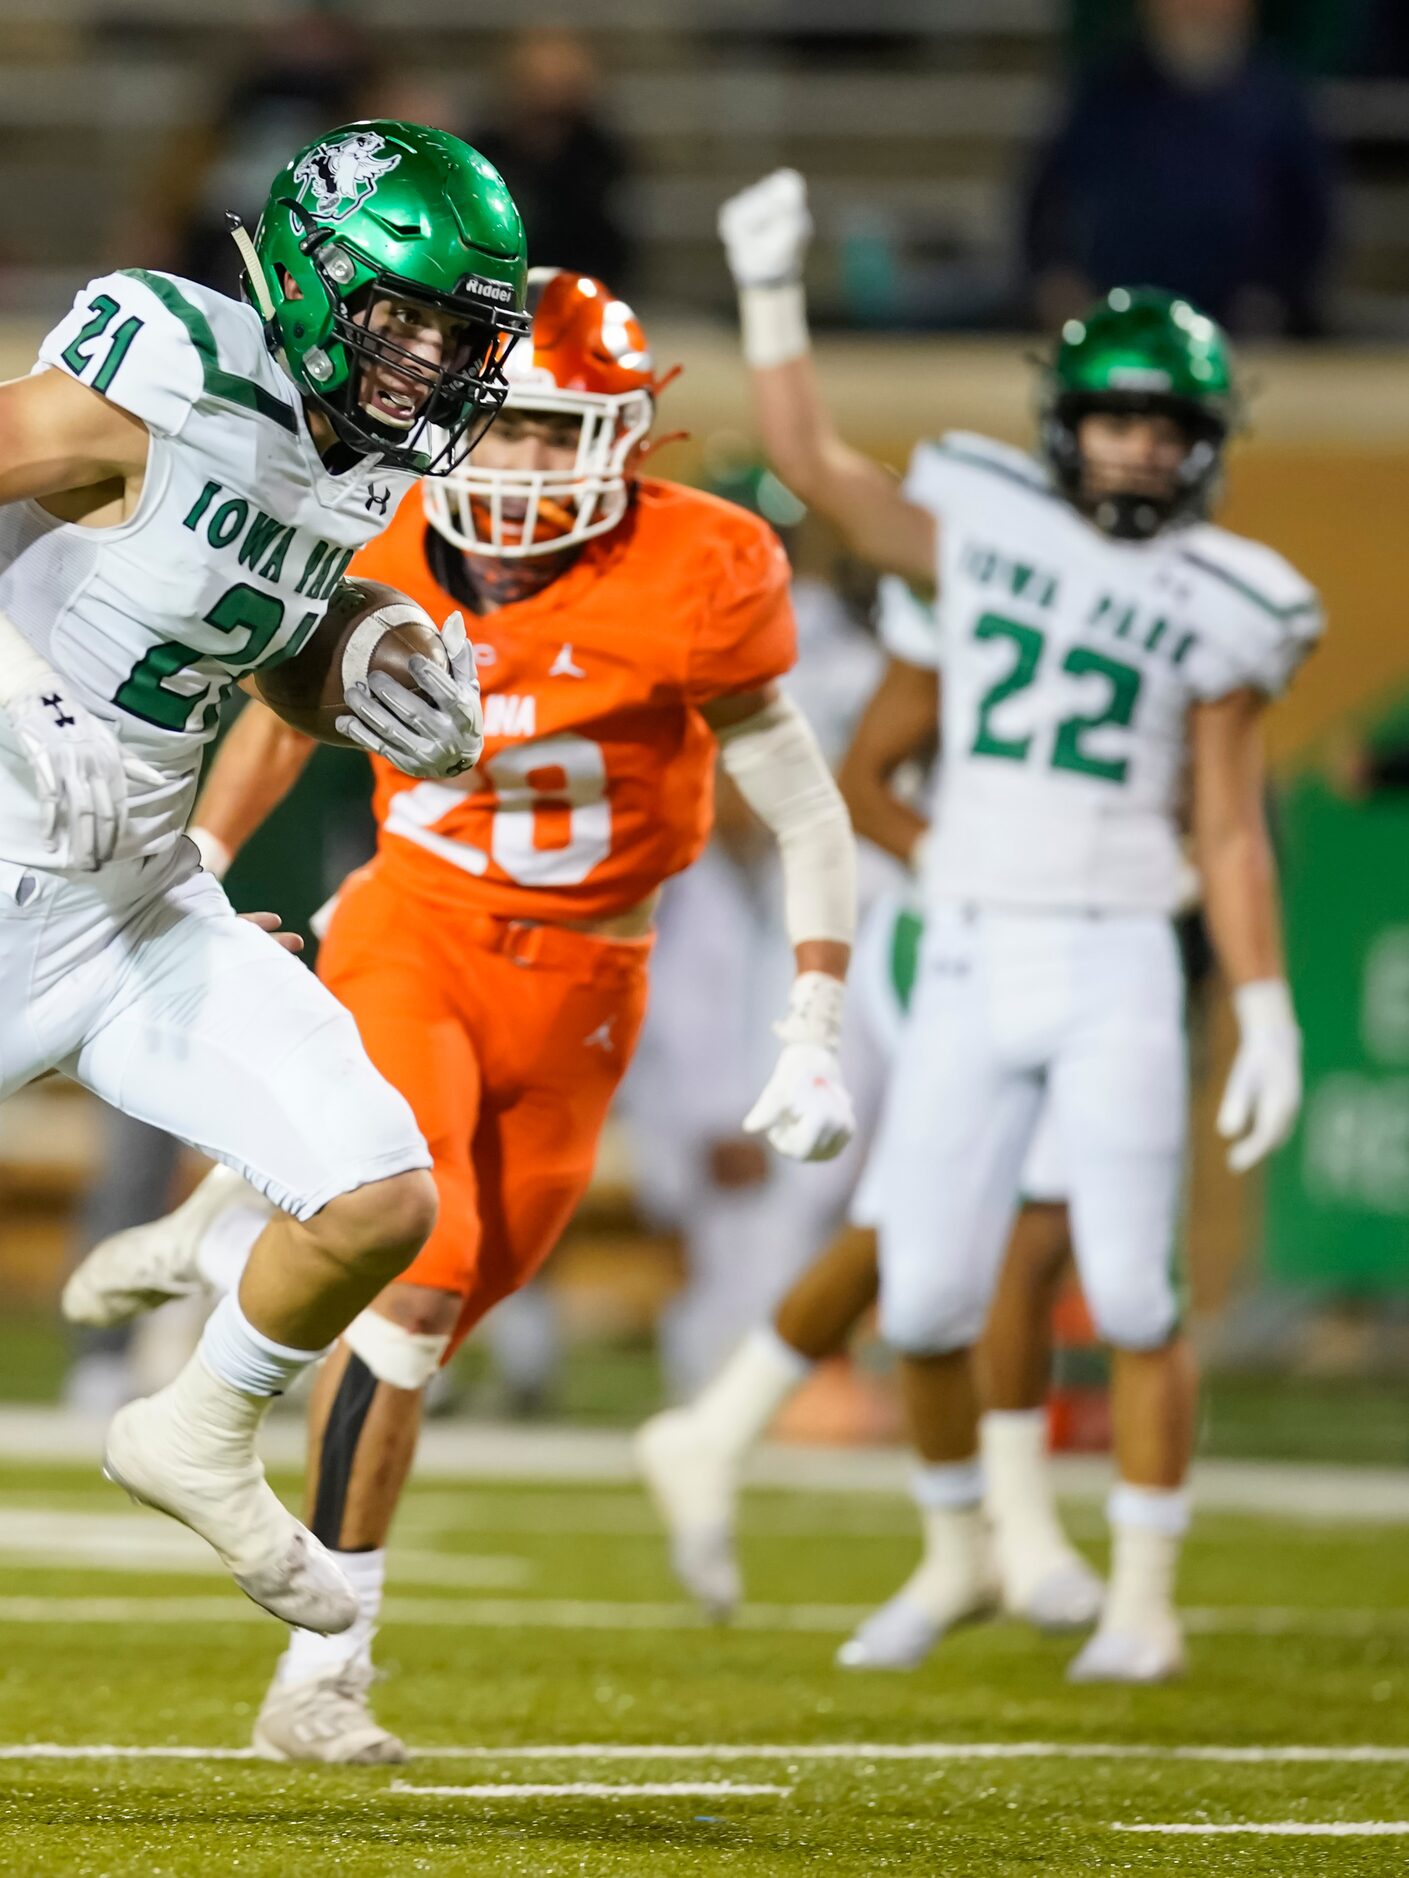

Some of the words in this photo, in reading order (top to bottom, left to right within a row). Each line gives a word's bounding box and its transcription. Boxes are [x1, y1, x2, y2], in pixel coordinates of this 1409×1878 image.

[465, 279, 512, 302] Riddel
[61, 294, 145, 394] 21
[183, 481, 297, 582] IOWA
[973, 612, 1142, 785] 22
[384, 735, 612, 886] 28
